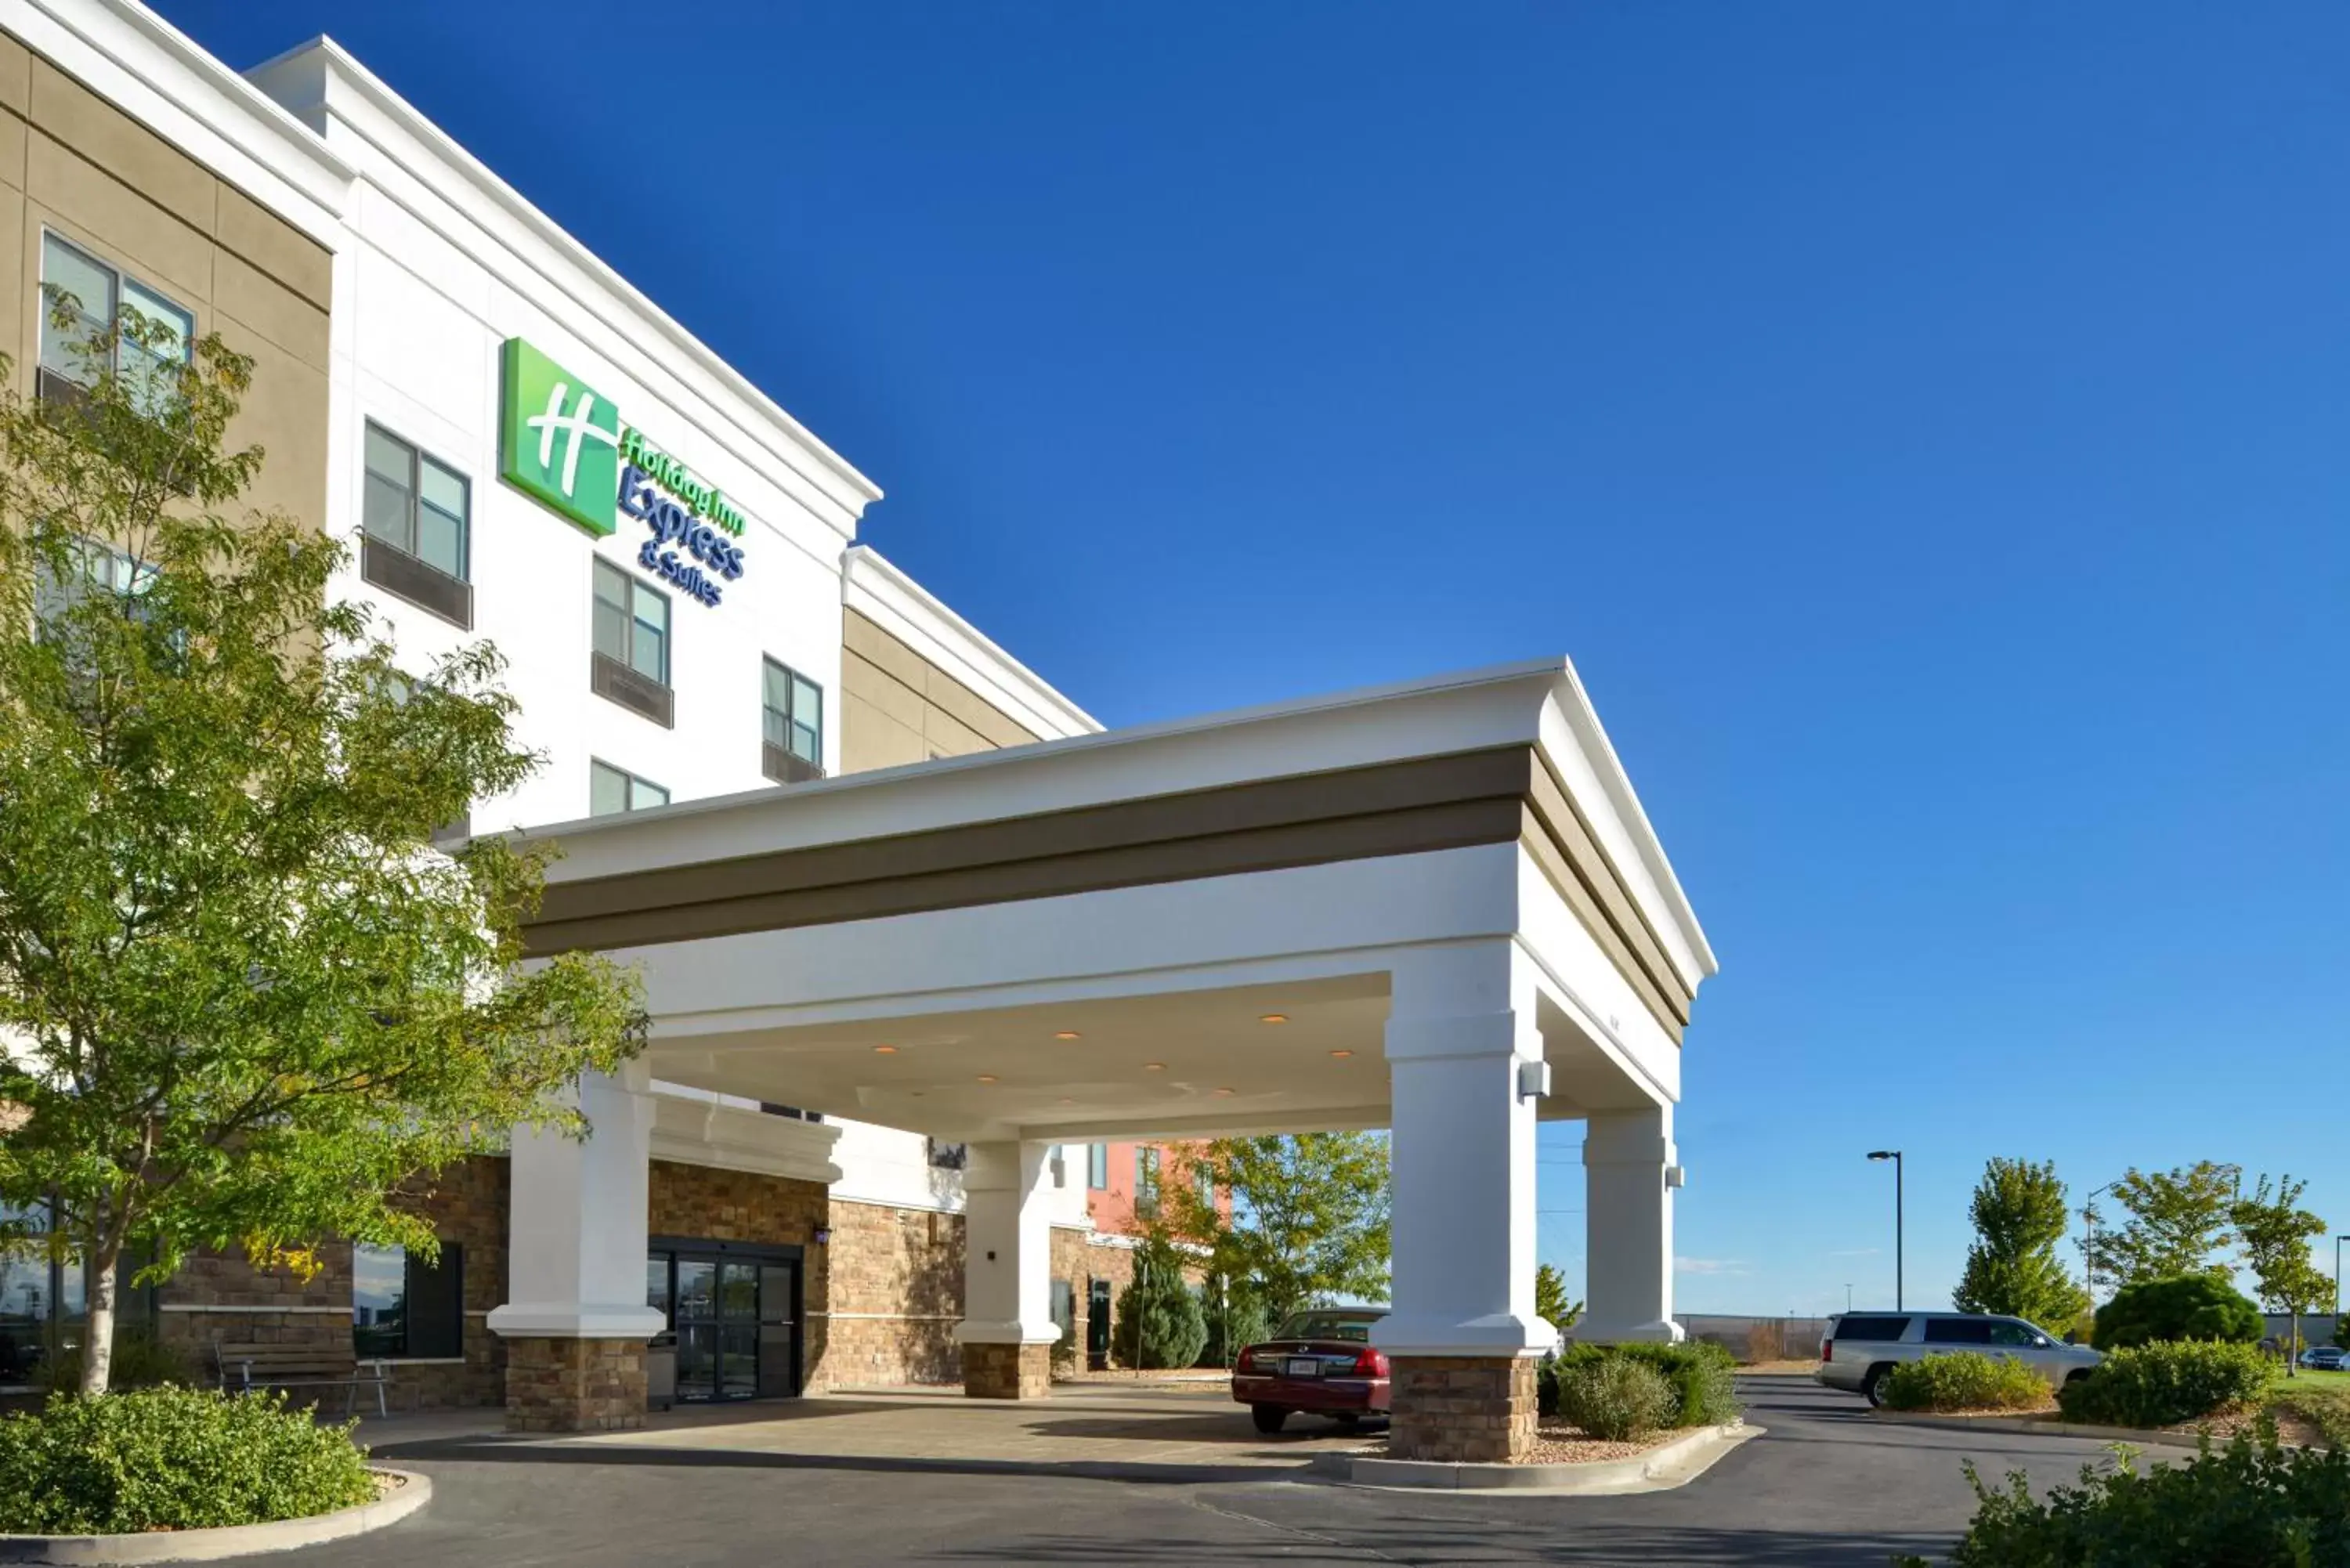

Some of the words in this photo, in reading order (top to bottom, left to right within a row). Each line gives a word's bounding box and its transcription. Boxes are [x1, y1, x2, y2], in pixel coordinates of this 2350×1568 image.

[618, 464, 745, 581] Express
[619, 427, 711, 516] Holiday
[707, 489, 746, 539] Inn
[638, 540, 660, 571] &
[656, 551, 723, 608] Suites
